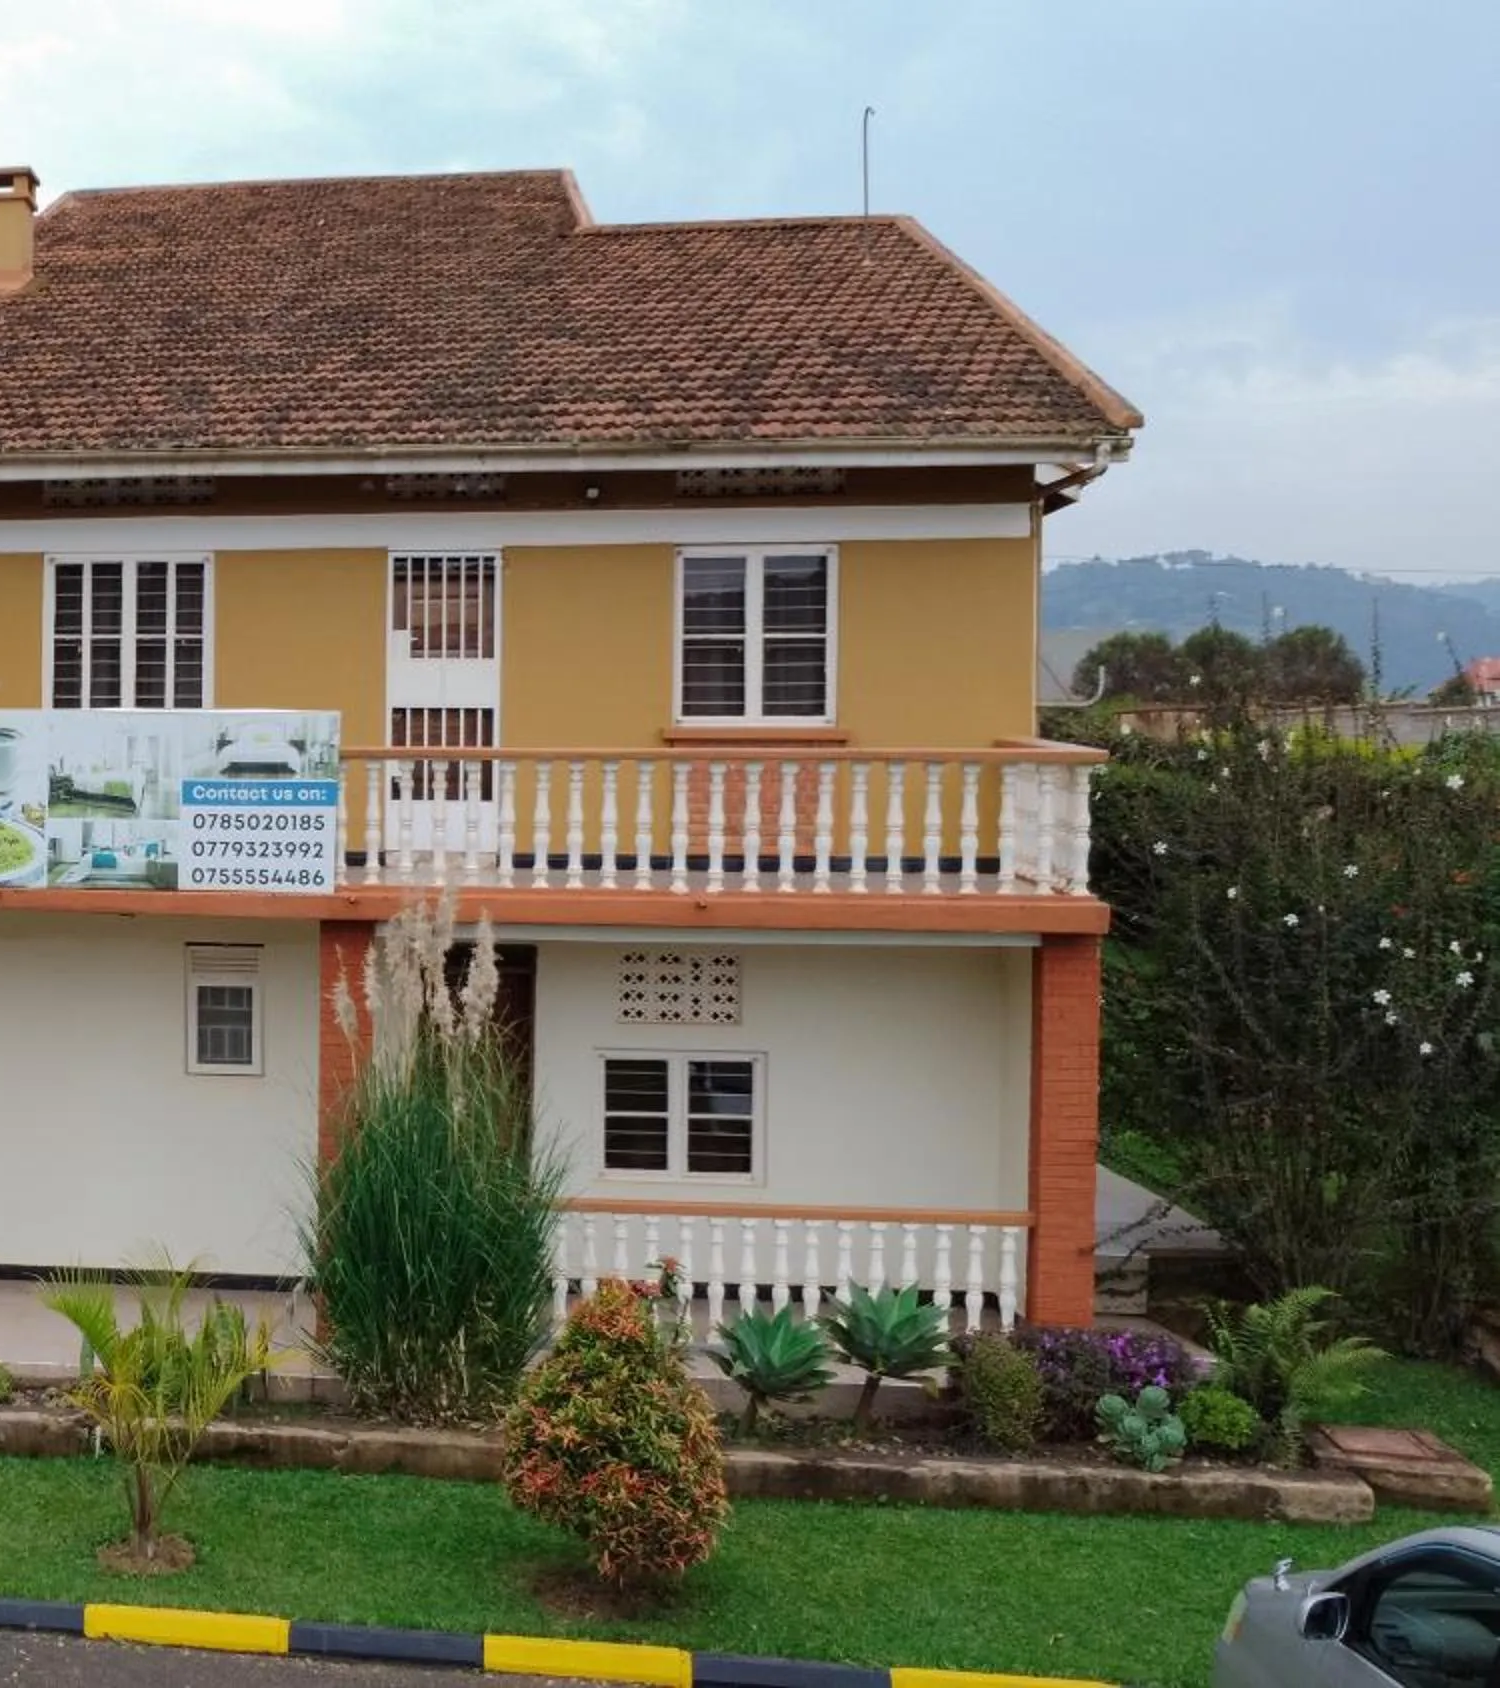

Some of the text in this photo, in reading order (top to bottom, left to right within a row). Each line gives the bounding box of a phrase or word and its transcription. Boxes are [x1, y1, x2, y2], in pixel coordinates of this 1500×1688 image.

[192, 785, 327, 800] Contact us on:
[193, 813, 325, 831] 0785020185
[192, 840, 324, 859] 0779323992
[192, 867, 325, 886] 0755554486
